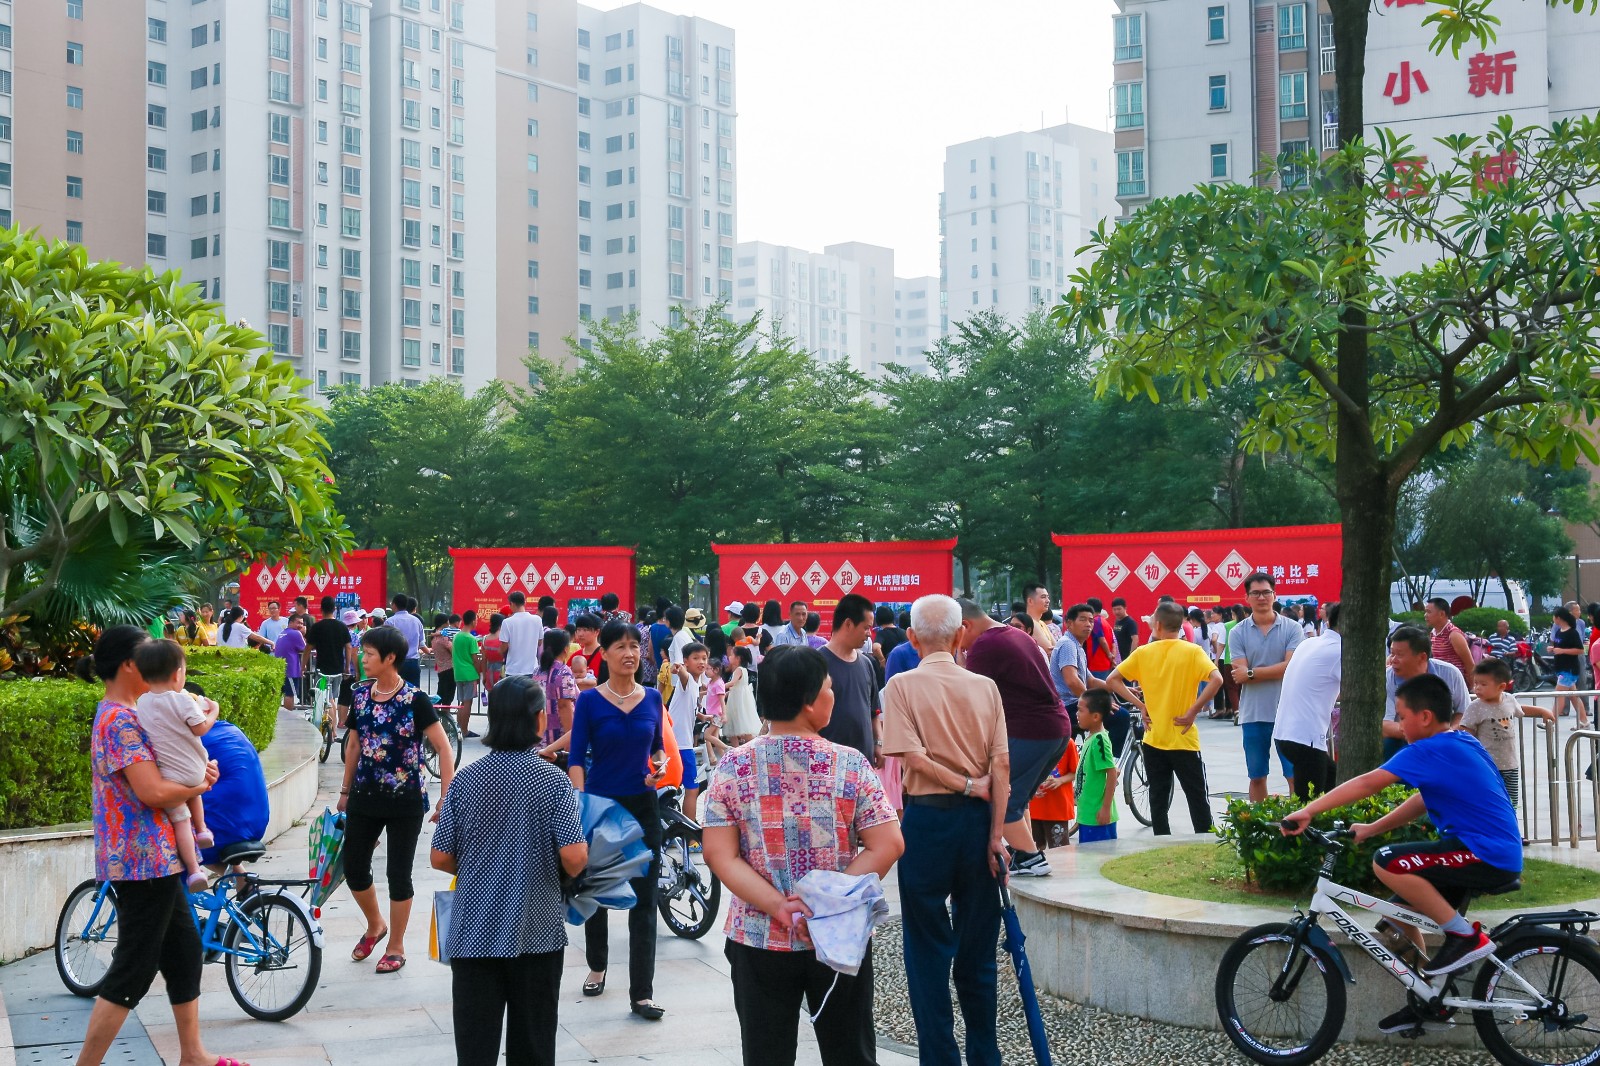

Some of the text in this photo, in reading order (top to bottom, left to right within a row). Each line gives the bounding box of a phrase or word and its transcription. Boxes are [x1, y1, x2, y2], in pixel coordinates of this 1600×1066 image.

[479, 571, 560, 586] 乐在其中
[750, 571, 920, 586] 爱的奔跑 猪八戒背媳妇
[1106, 561, 1243, 582] 岁物丰成
[1326, 911, 1394, 962] FOREVER
